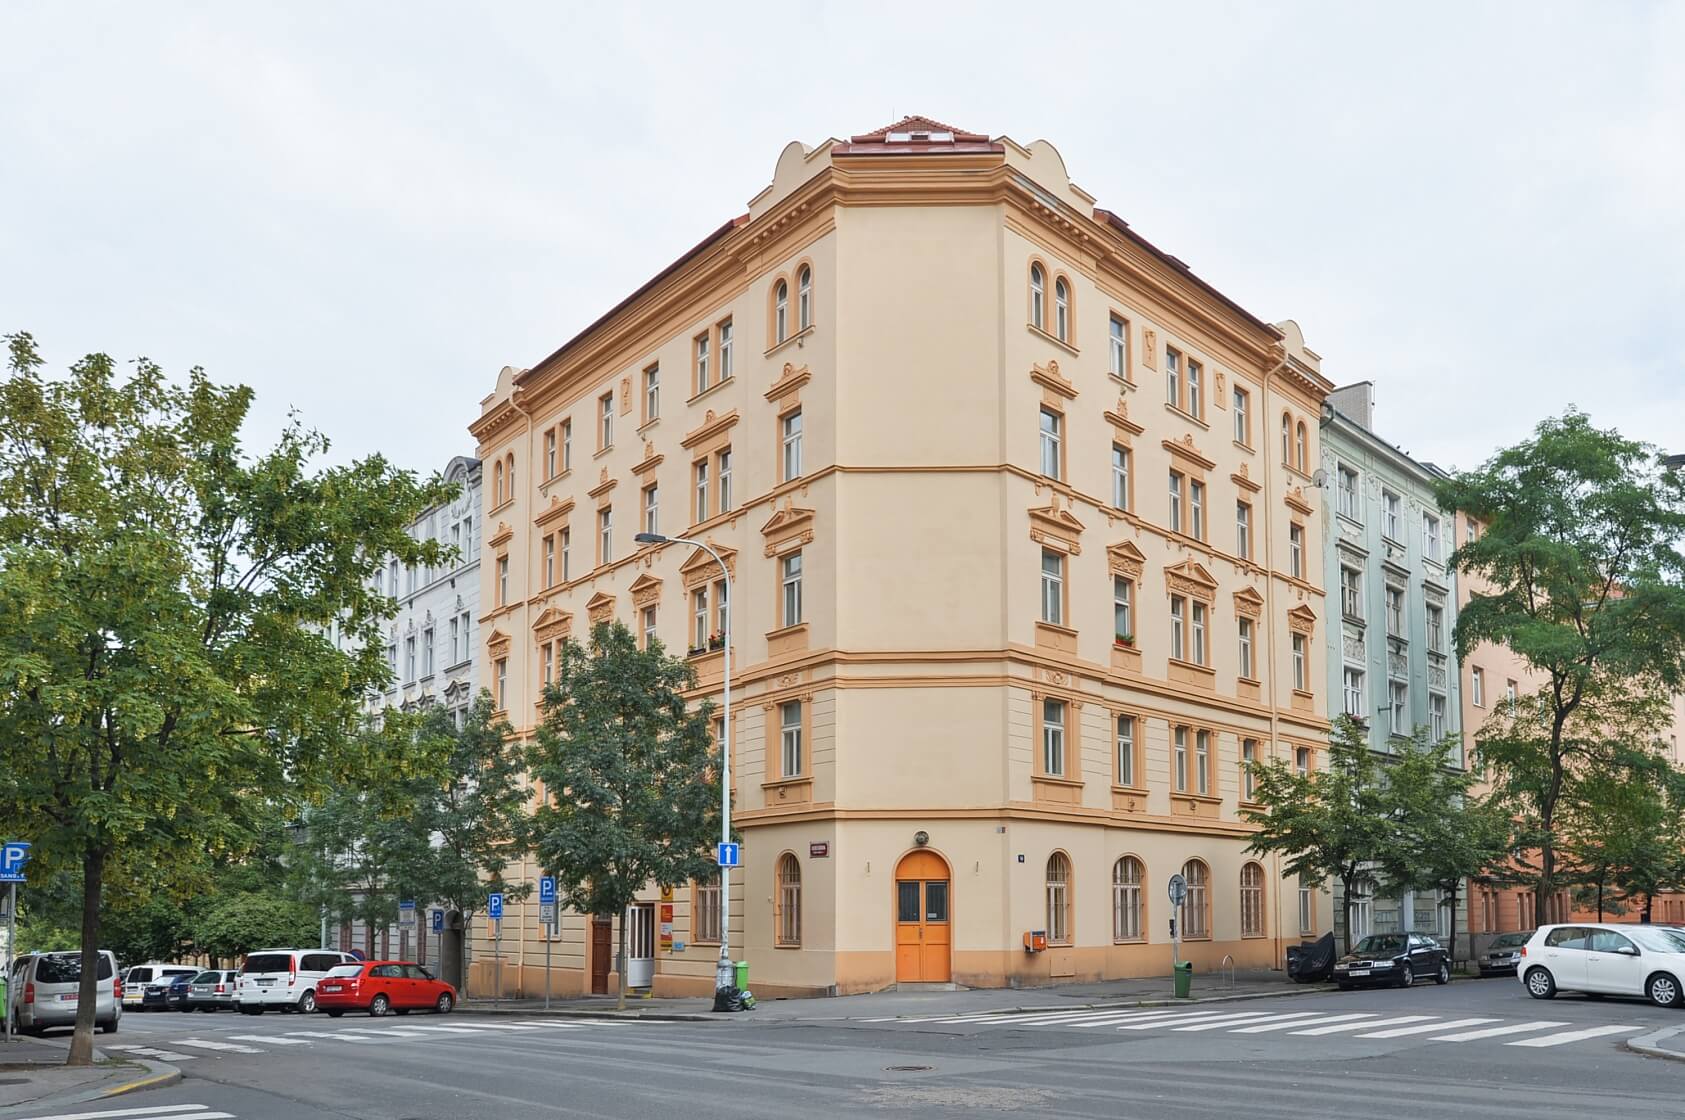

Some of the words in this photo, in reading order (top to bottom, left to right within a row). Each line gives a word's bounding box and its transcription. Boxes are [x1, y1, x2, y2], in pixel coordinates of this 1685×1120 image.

[5, 847, 24, 869] P
[542, 880, 552, 896] P
[491, 896, 500, 912] P
[434, 913, 442, 927] P
